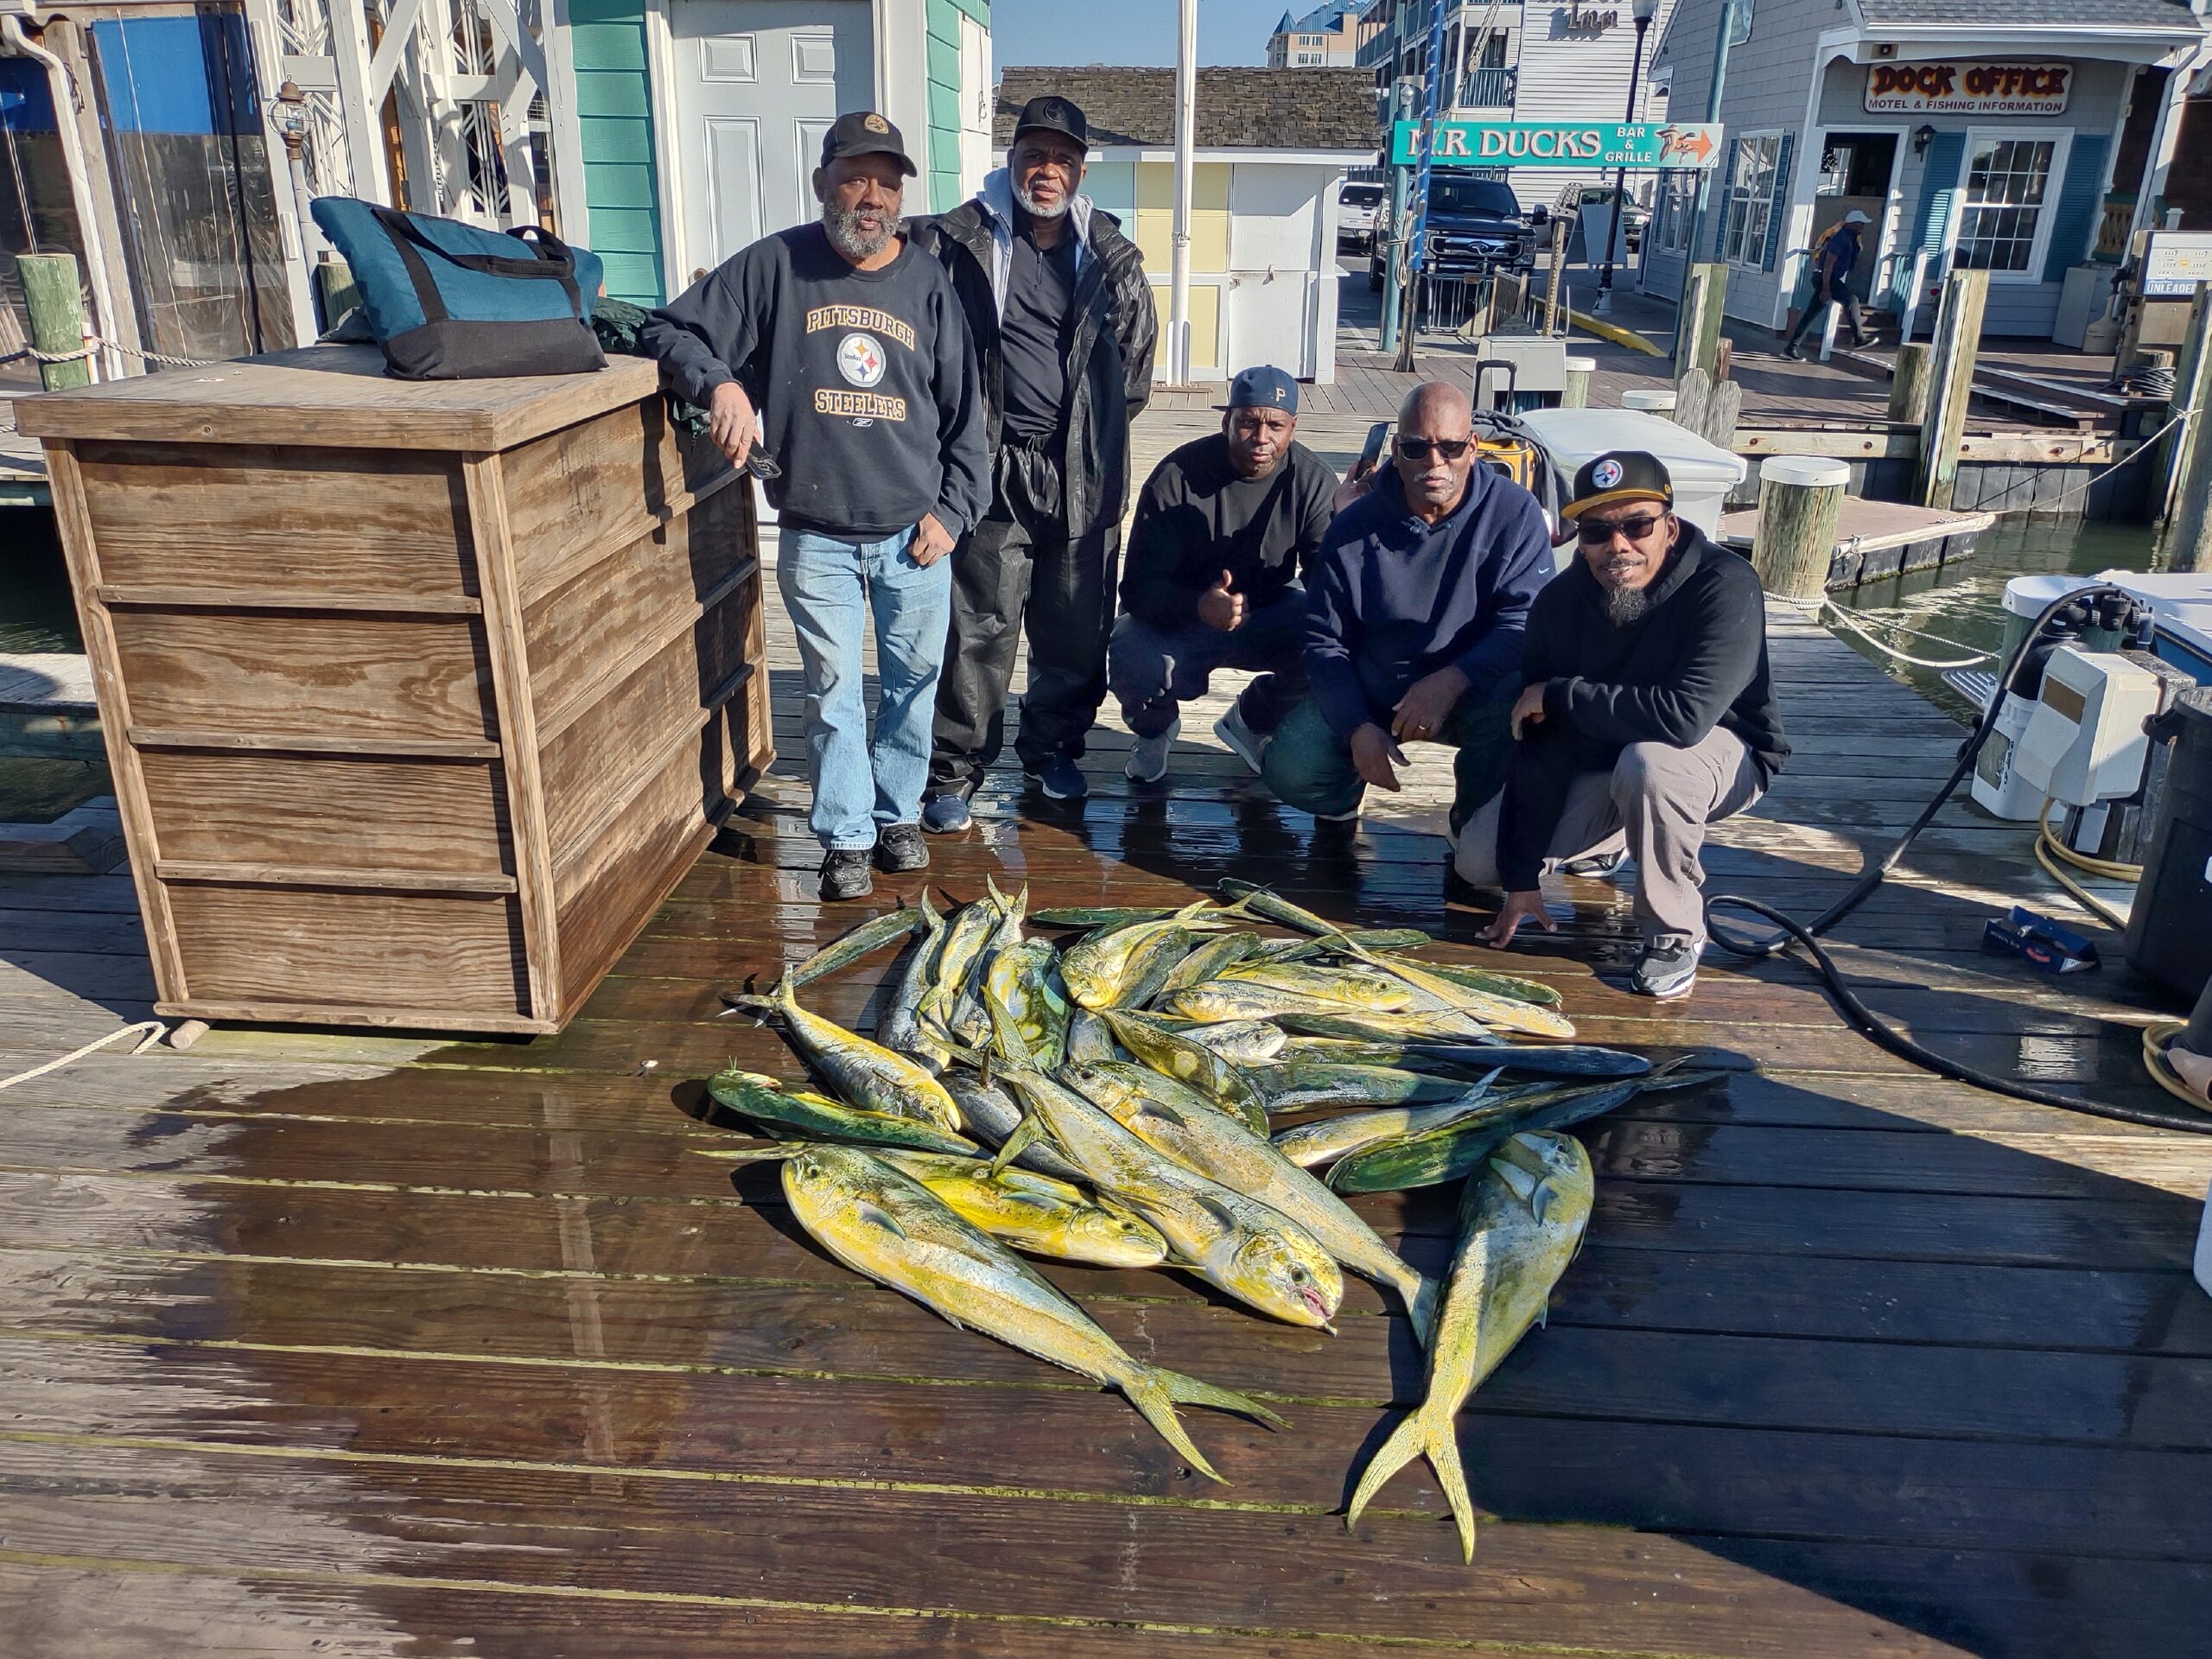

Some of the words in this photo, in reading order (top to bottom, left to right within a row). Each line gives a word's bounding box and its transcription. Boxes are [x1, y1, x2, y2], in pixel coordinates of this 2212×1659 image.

[1567, 3, 1618, 29] Inn
[1872, 65, 1957, 98] DOCK
[1963, 67, 2069, 98] OFFICE
[1868, 99, 1908, 109] MOTEL
[1914, 100, 1922, 109] &
[1926, 100, 1975, 111] FISHING
[1978, 101, 2063, 111] INFORMATION
[1617, 126, 1645, 137] BAR
[1478, 130, 1601, 158] DUCKS
[1624, 139, 1634, 149] &
[1605, 151, 1652, 162] GRILLE
[807, 305, 914, 351] PITTSBURGH
[1275, 387, 1286, 402] P
[815, 389, 906, 421] STEELERS
